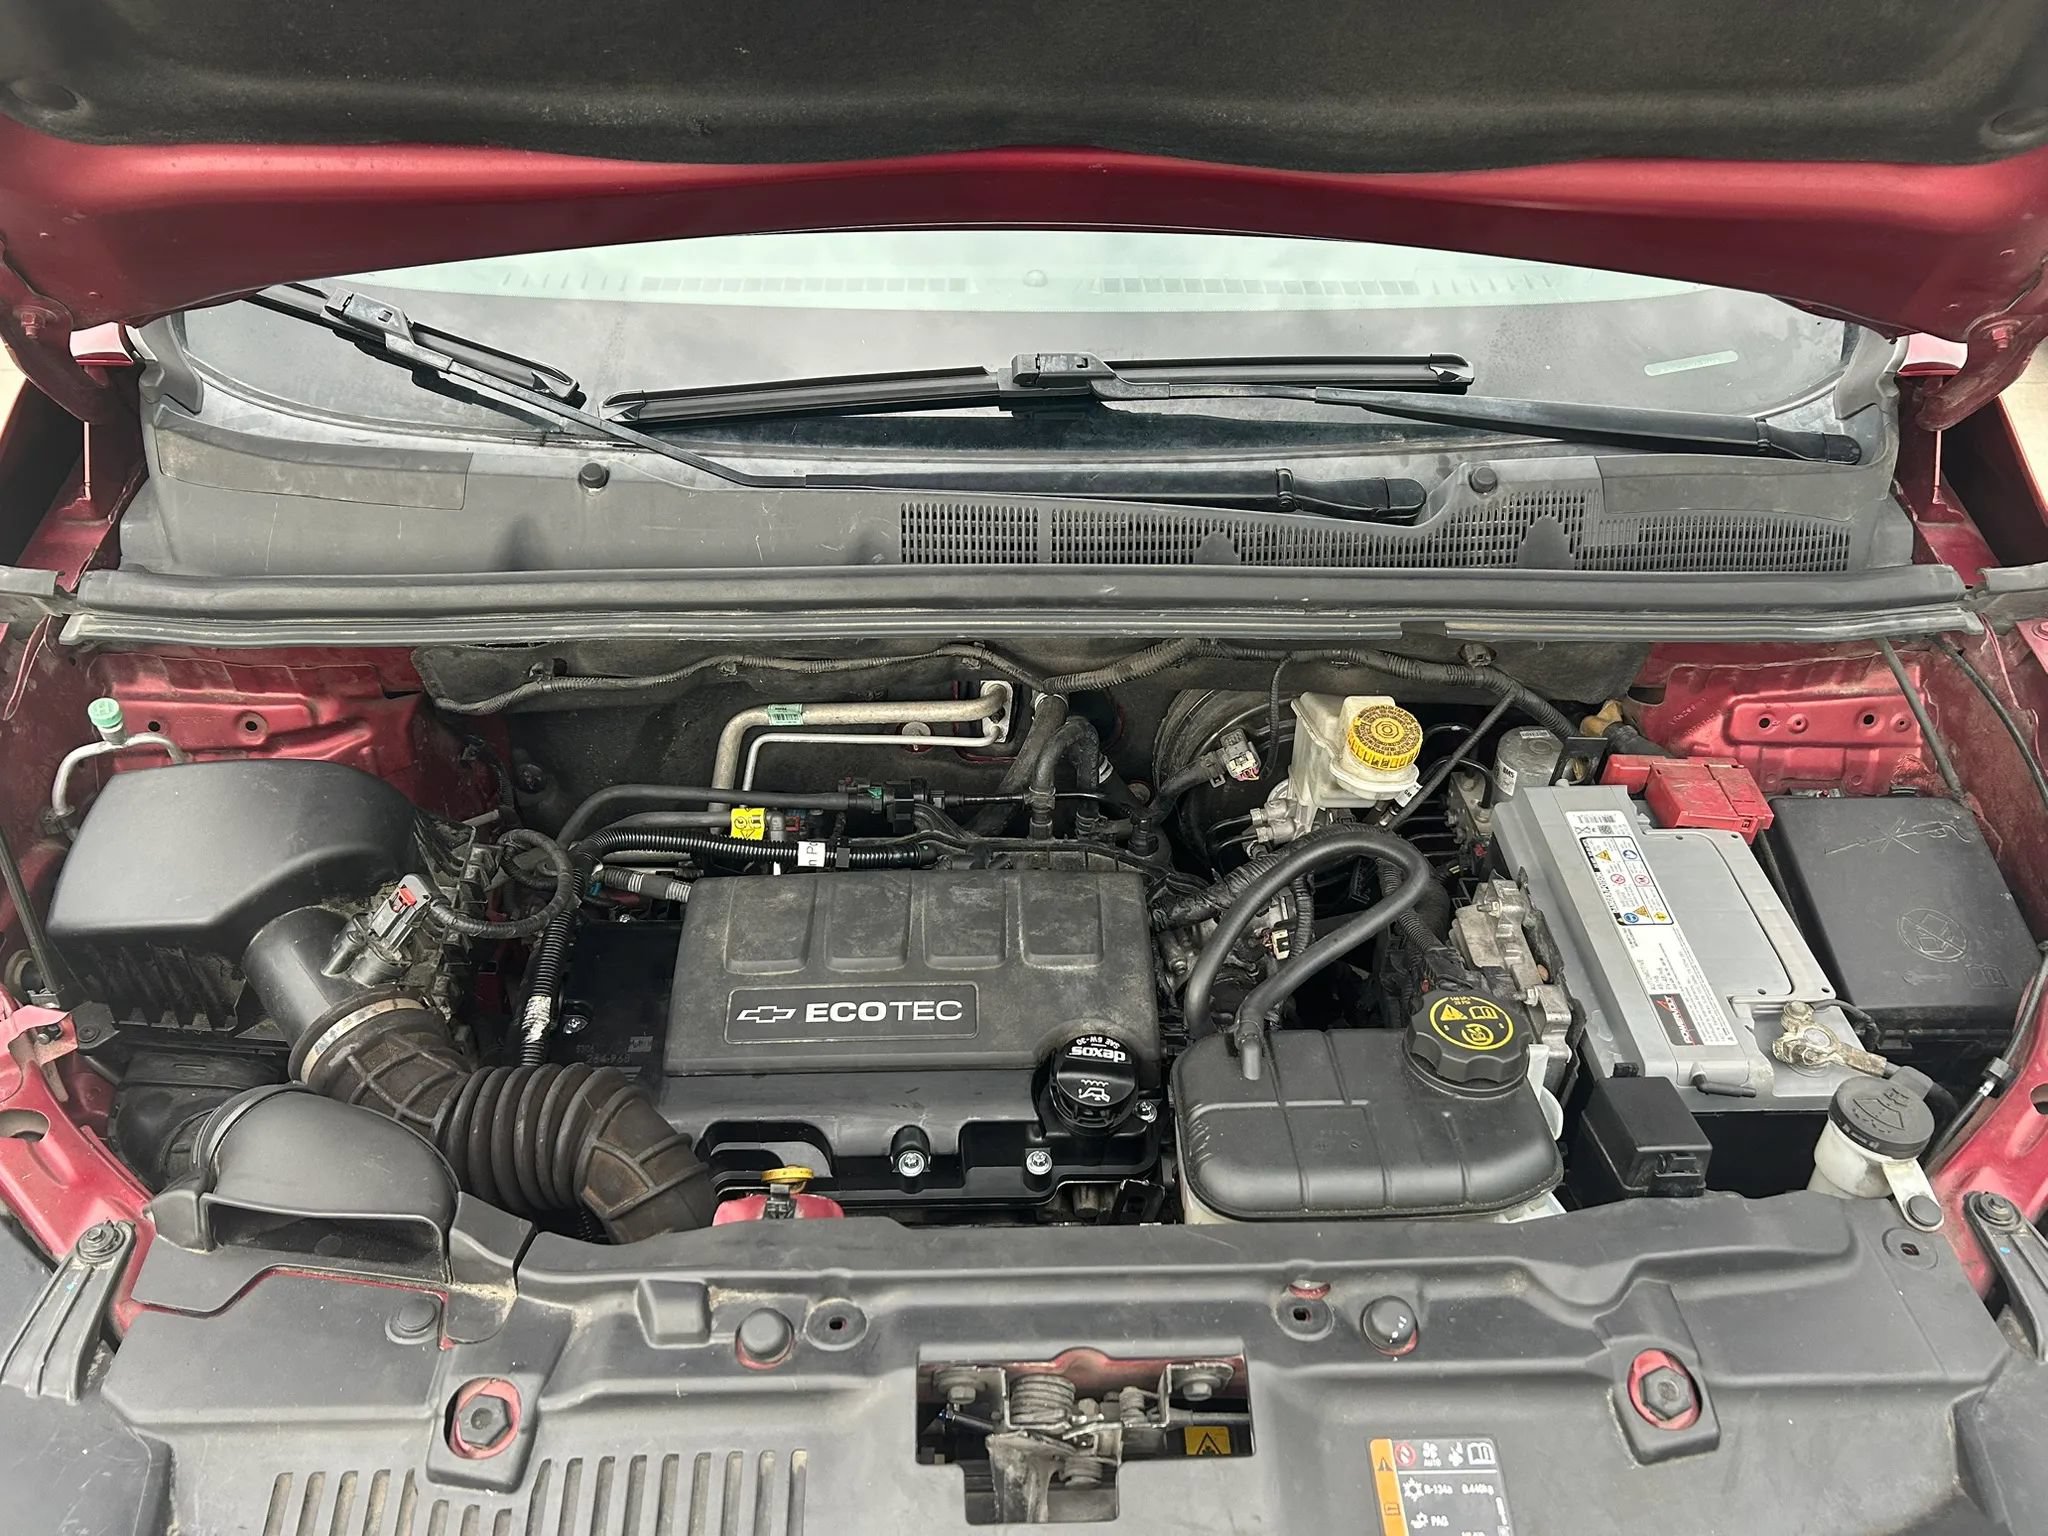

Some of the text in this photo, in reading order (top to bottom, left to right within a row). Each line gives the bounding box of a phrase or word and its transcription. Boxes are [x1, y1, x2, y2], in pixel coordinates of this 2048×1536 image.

[804, 1000, 963, 1024] ECOTEC
[1664, 995, 1693, 1044] POWERVOLT
[1105, 1037, 1121, 1049] SAE
[1070, 1045, 1126, 1062] dexos
